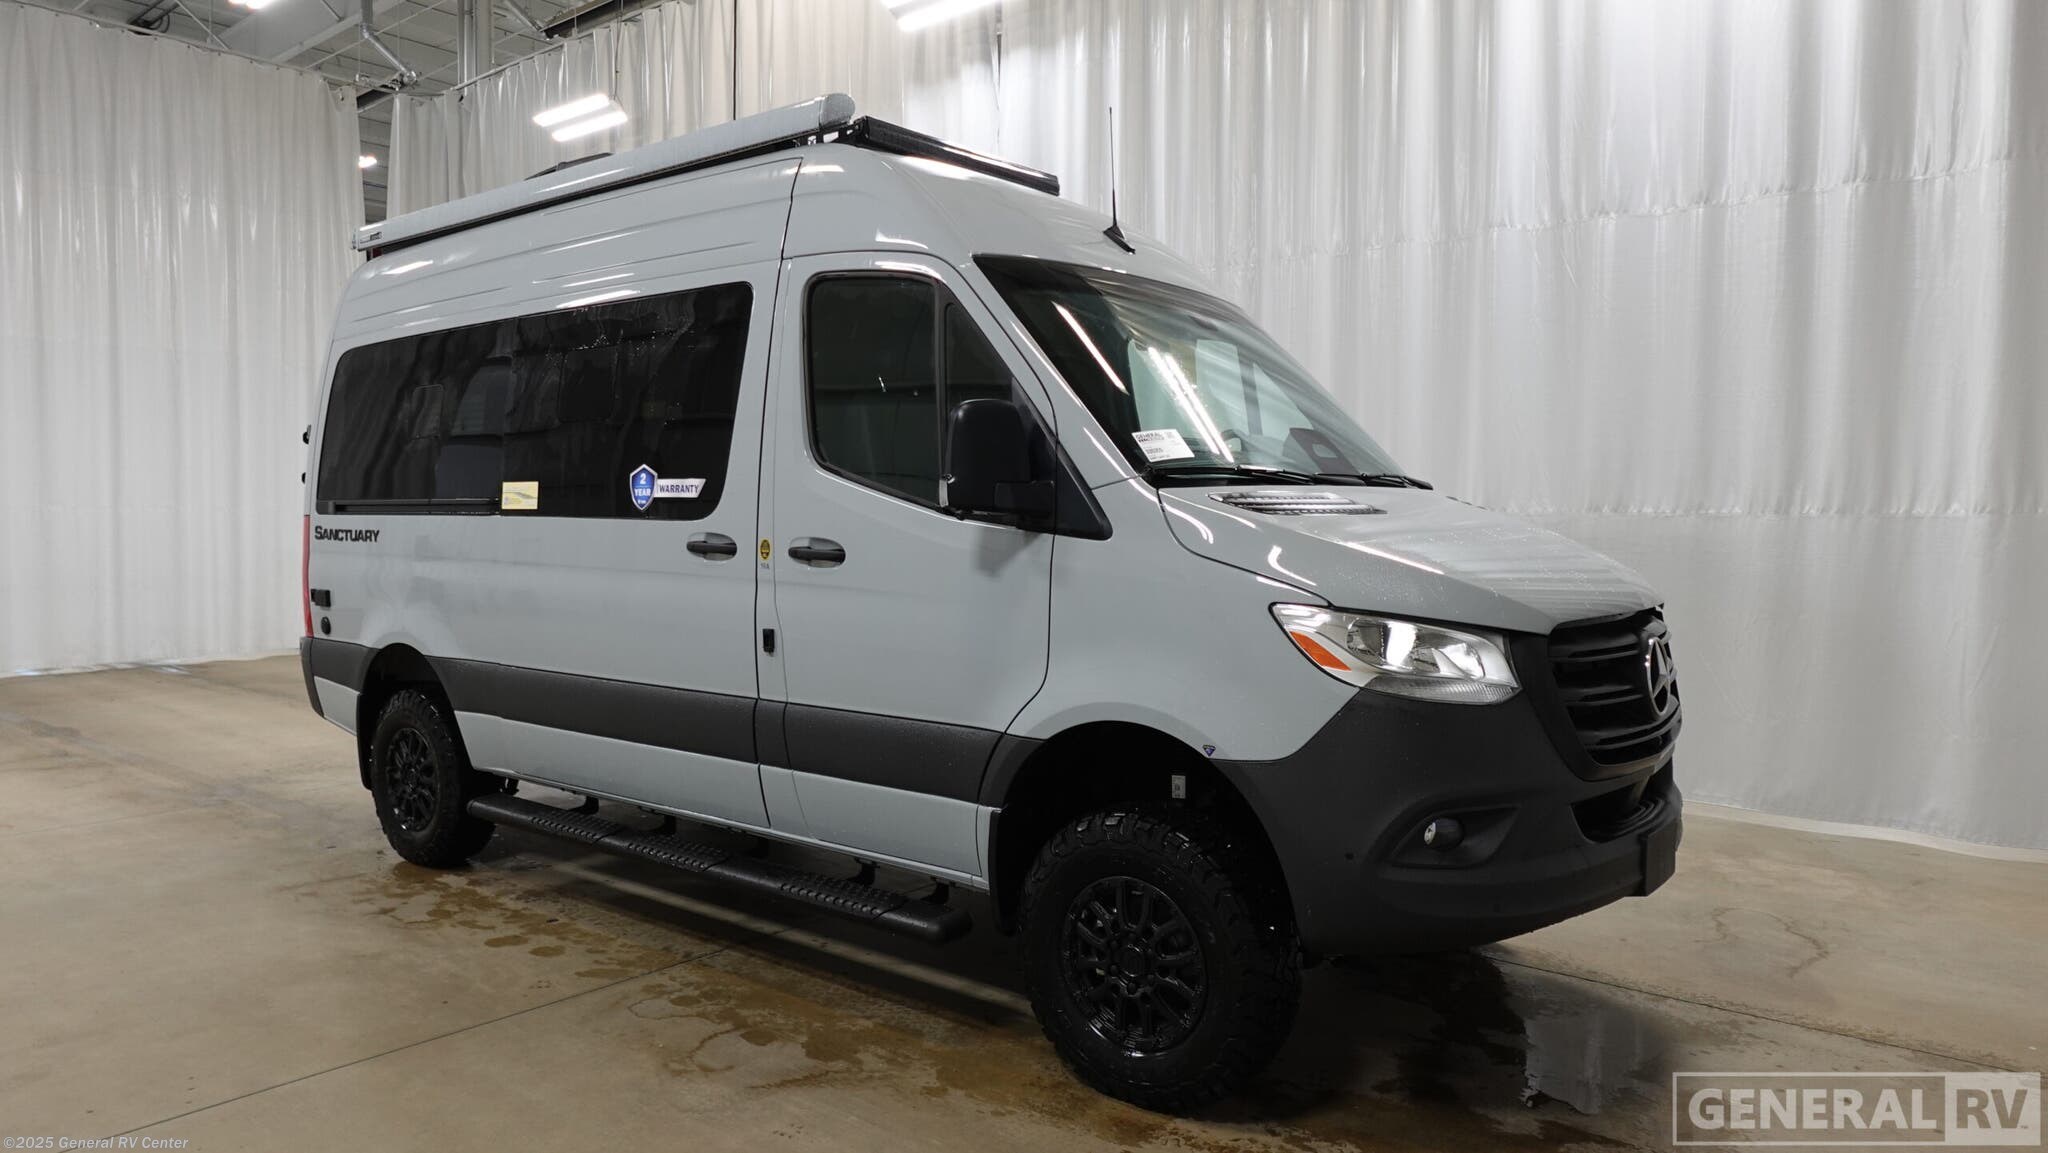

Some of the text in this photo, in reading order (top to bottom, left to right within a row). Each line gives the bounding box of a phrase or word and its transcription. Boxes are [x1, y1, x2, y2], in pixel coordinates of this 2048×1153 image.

[640, 472, 647, 484] 2
[634, 488, 651, 497] YEAR
[659, 484, 699, 494] WARRANTY
[314, 525, 380, 543] SANCTUARY
